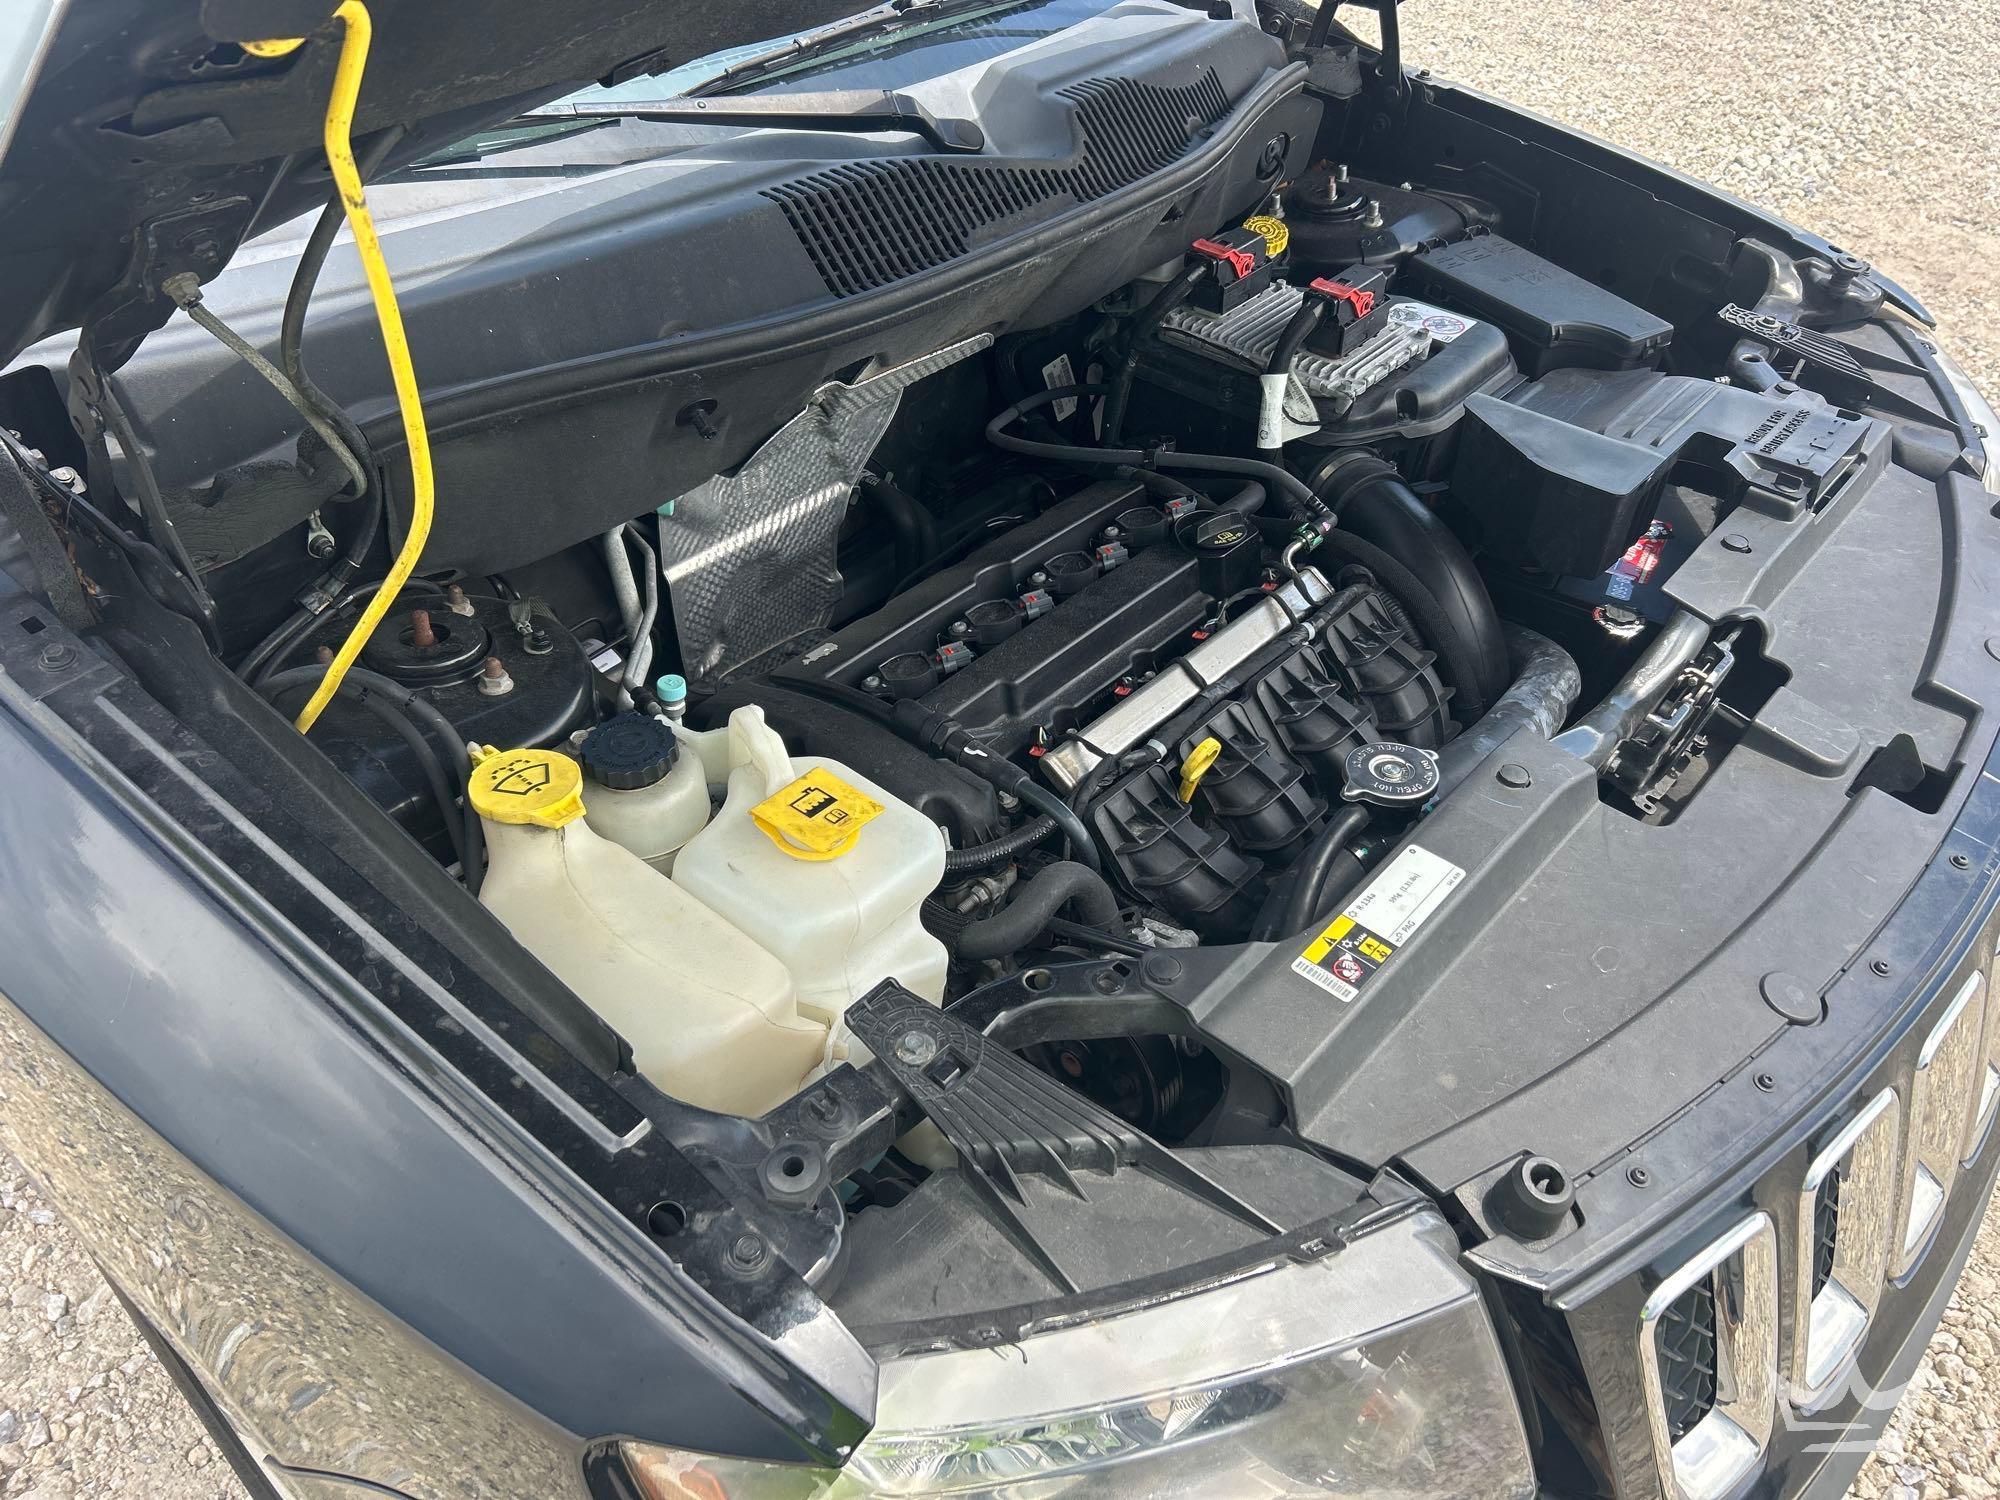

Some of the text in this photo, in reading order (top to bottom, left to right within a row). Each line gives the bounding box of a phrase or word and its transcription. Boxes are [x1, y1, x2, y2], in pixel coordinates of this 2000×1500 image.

[1373, 781, 1393, 793] HOT
[1395, 782, 1423, 794] OPEN
[1355, 892, 1376, 911] R-134a
[1401, 920, 1416, 933] PAG
